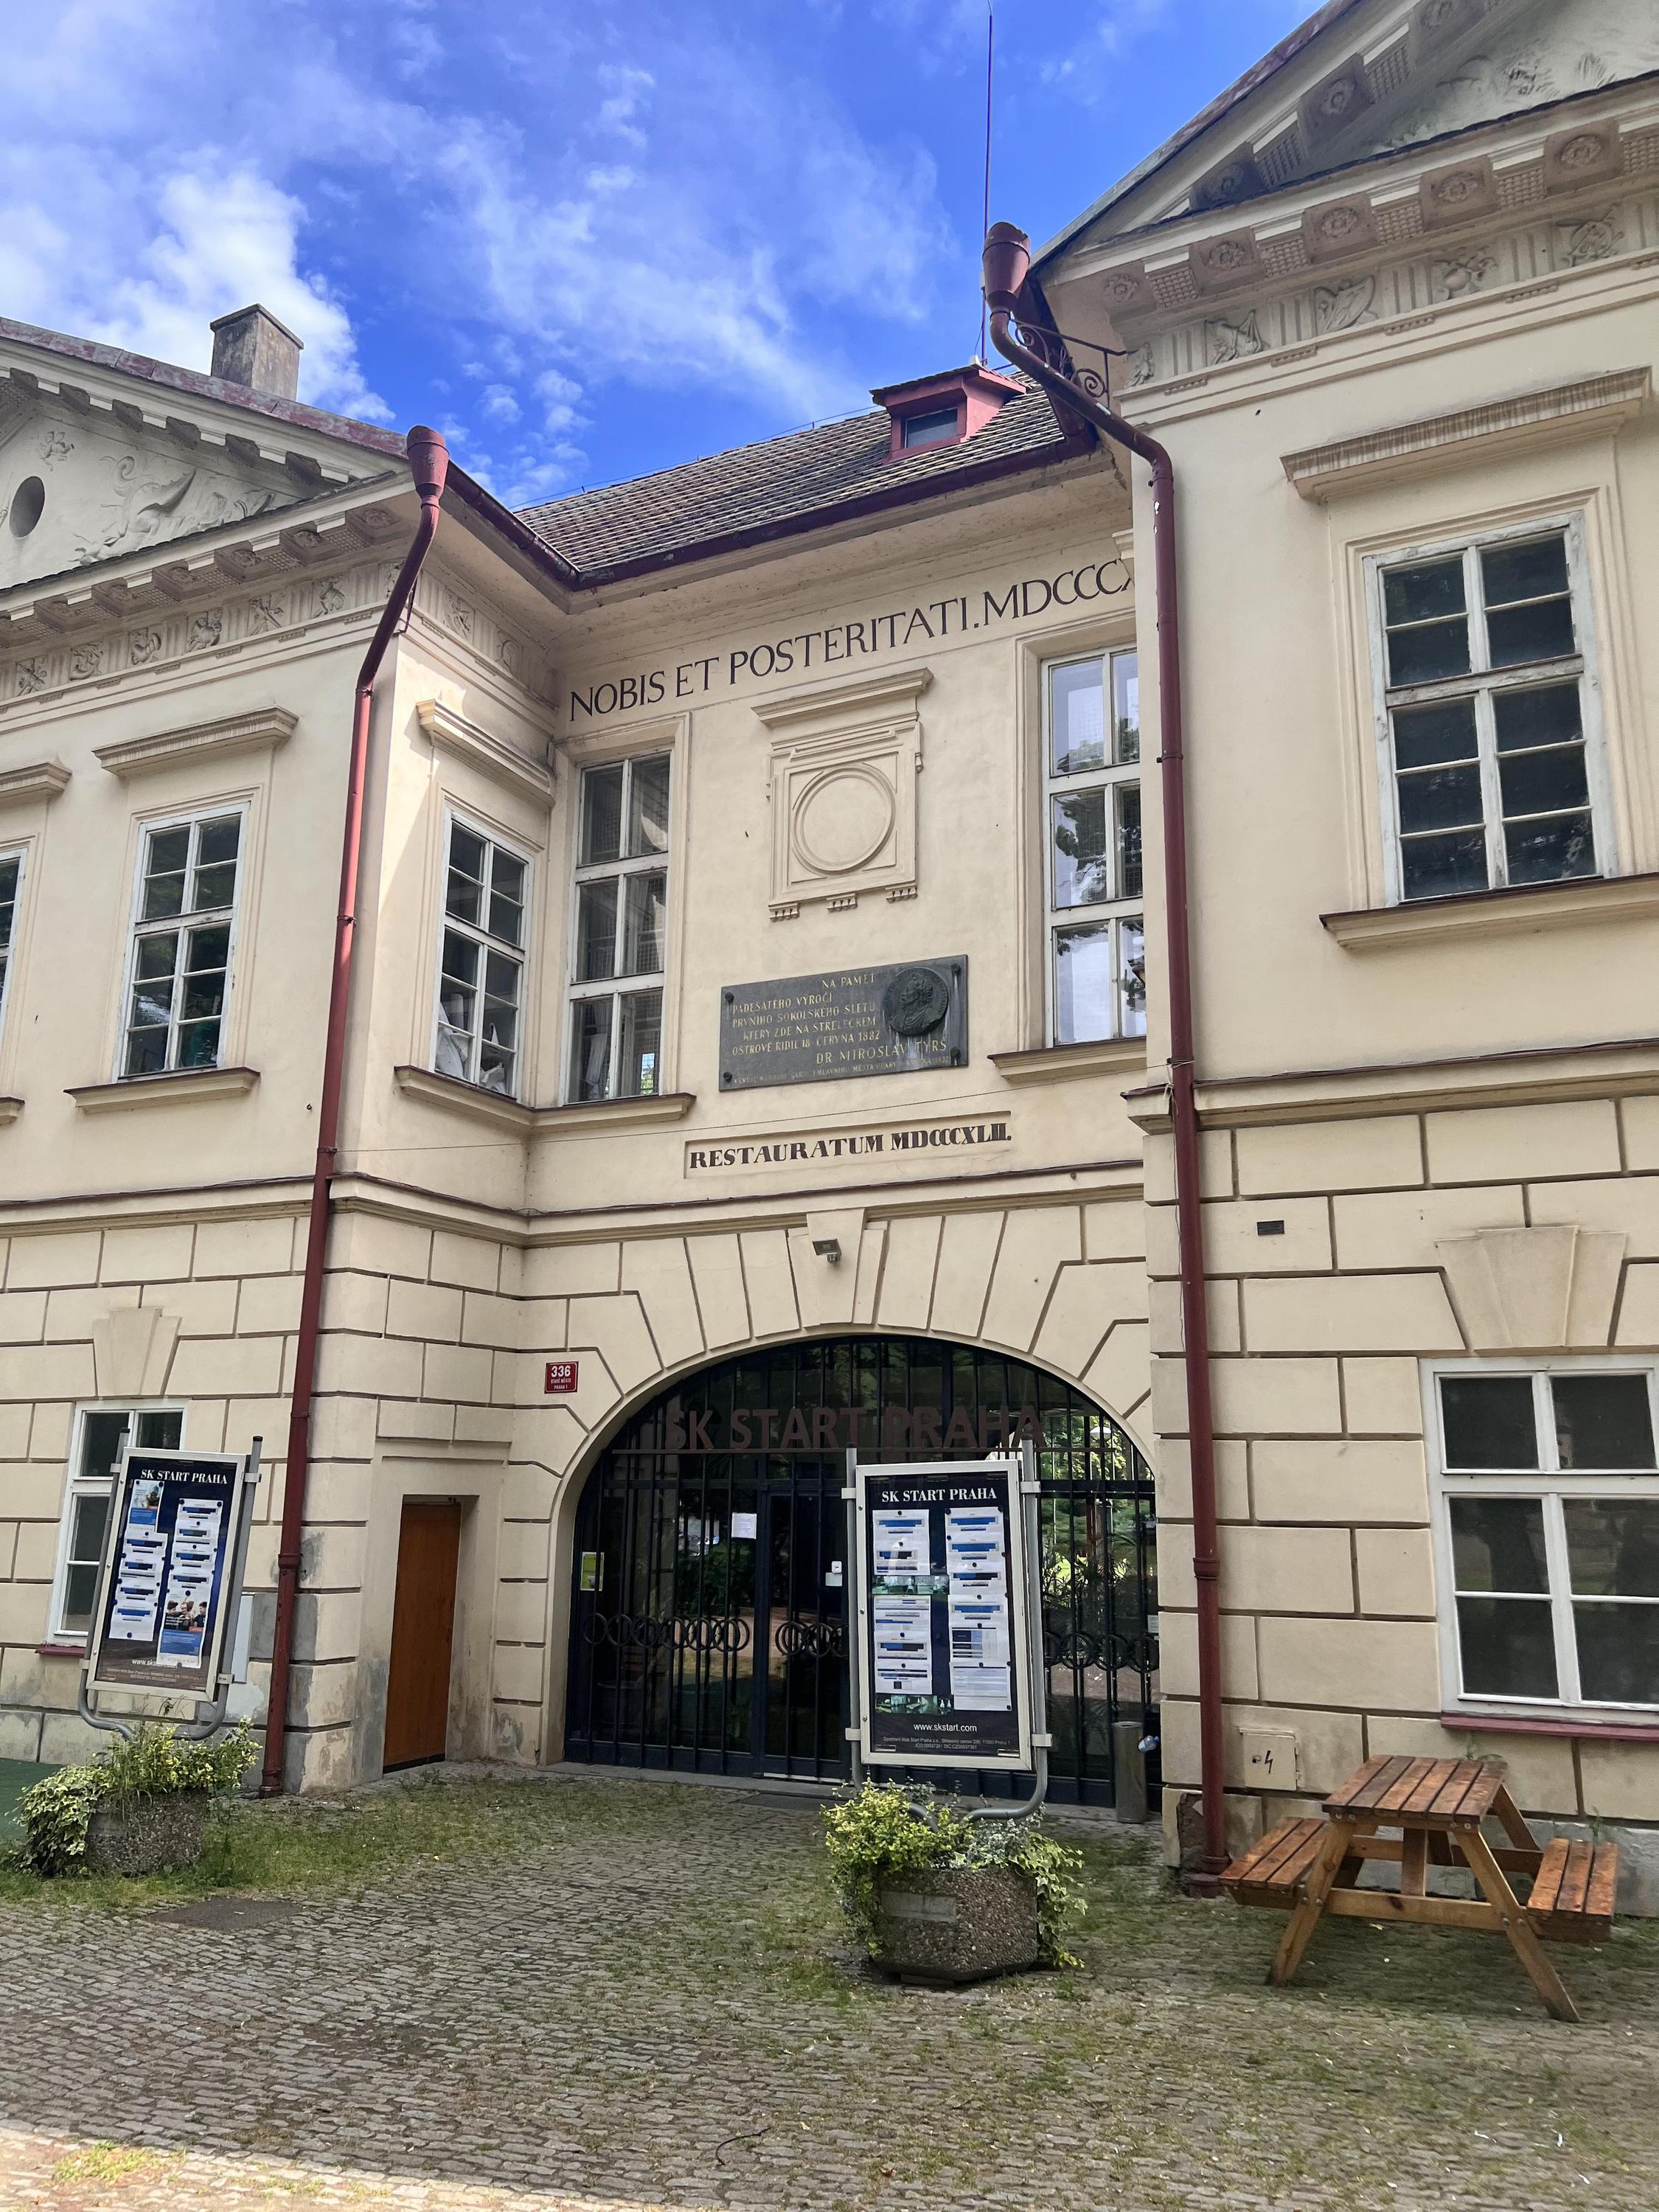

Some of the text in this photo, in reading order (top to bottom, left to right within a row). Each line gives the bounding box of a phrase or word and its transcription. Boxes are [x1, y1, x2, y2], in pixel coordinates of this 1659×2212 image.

[570, 670, 665, 721] NOBIS
[675, 658, 719, 697] ET
[822, 979, 836, 989] NA
[774, 1026, 792, 1037] ZDE
[796, 1025, 809, 1034] NA
[858, 1030, 880, 1042] 1882
[840, 1043, 908, 1062] MIROSLAV
[689, 1134, 884, 1169] RESTAURATUM
[552, 1365, 571, 1377] 336
[666, 1403, 1044, 1450] SK START PRAHA
[141, 1469, 227, 1484] SK START PRAHA
[882, 1487, 997, 1503] SK START PRAHA
[914, 1722, 977, 1732] www.skstart.com
